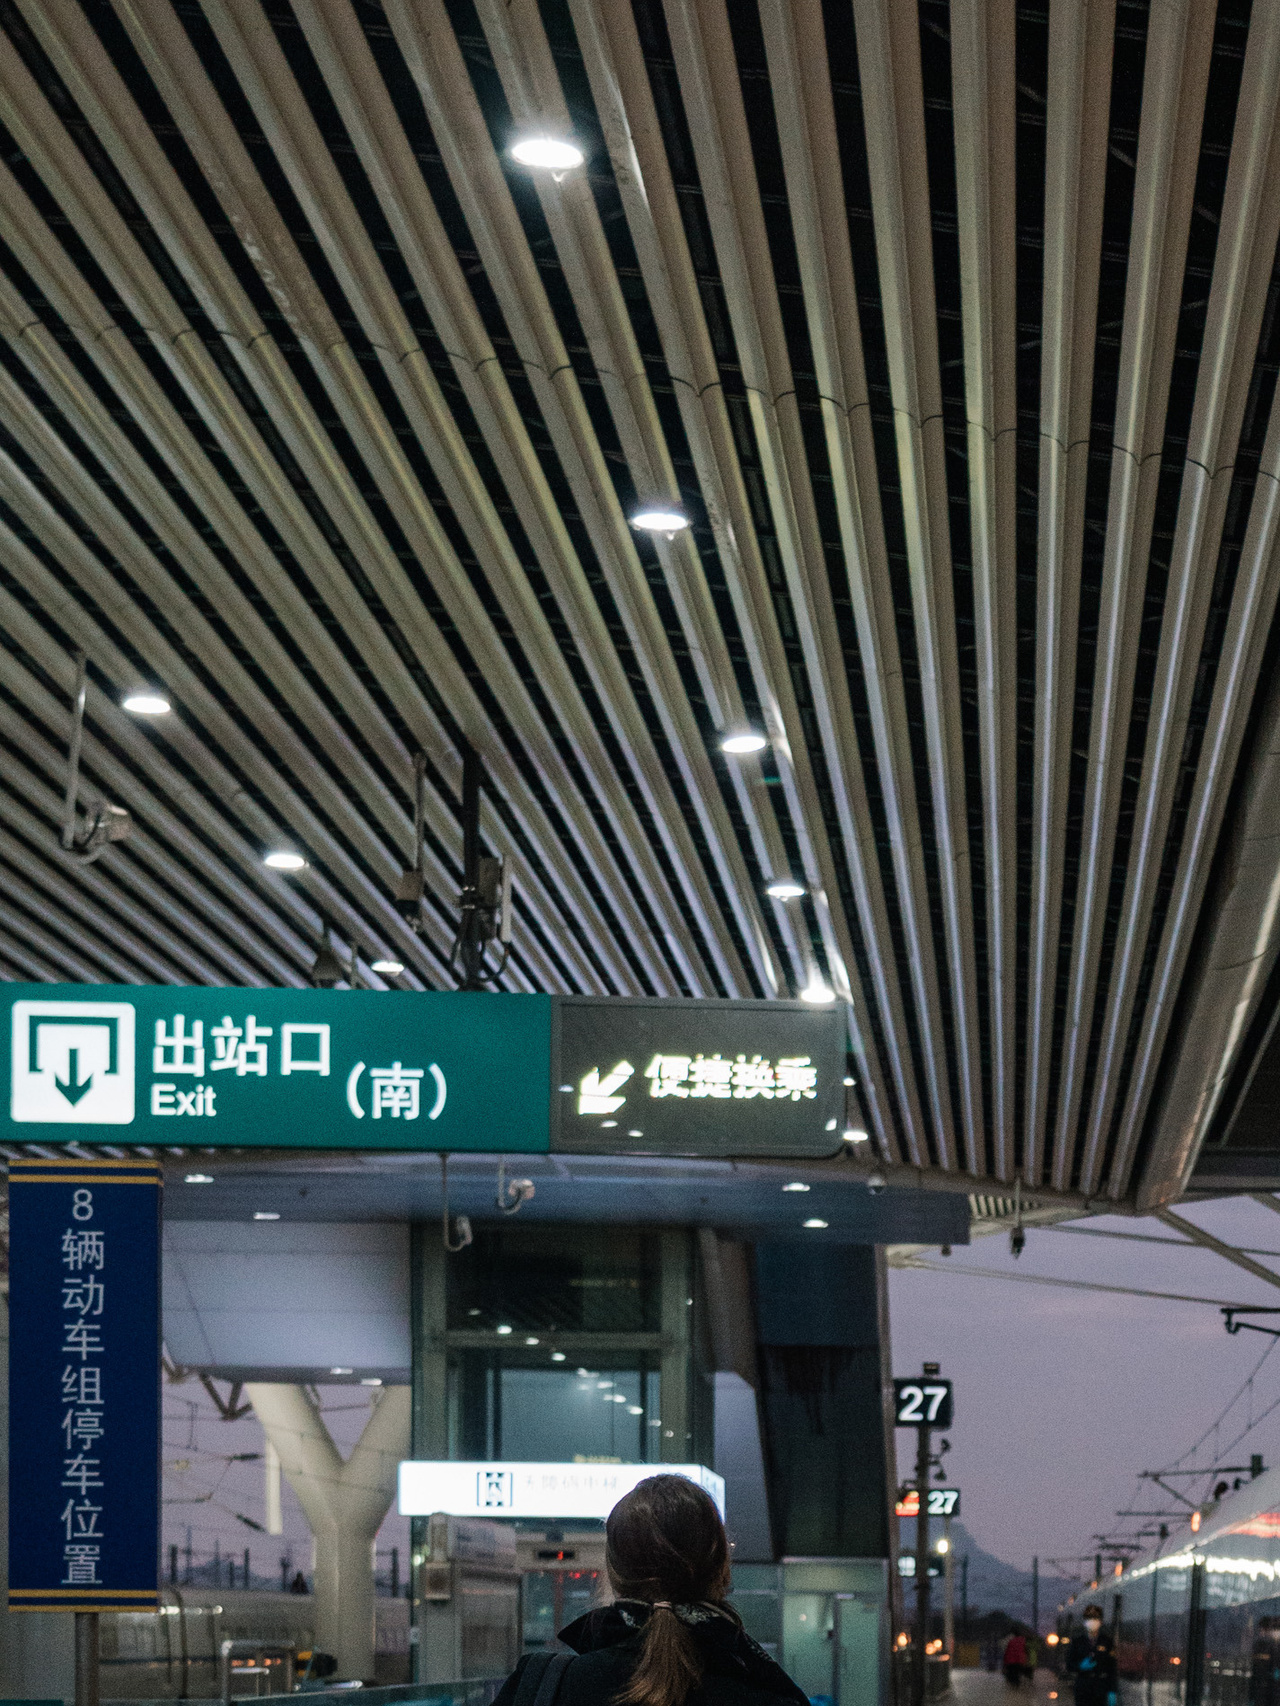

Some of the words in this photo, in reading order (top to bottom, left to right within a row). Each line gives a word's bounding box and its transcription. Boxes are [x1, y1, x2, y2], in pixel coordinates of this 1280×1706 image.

[153, 1013, 331, 1077] 出站口
[151, 1083, 217, 1117] Exit
[346, 1061, 448, 1121] (南)
[645, 1054, 817, 1100] 便捷换乘
[61, 1189, 105, 1587] 8辆动车组停车位置
[898, 1386, 948, 1421] 27
[927, 1490, 959, 1515] 27
